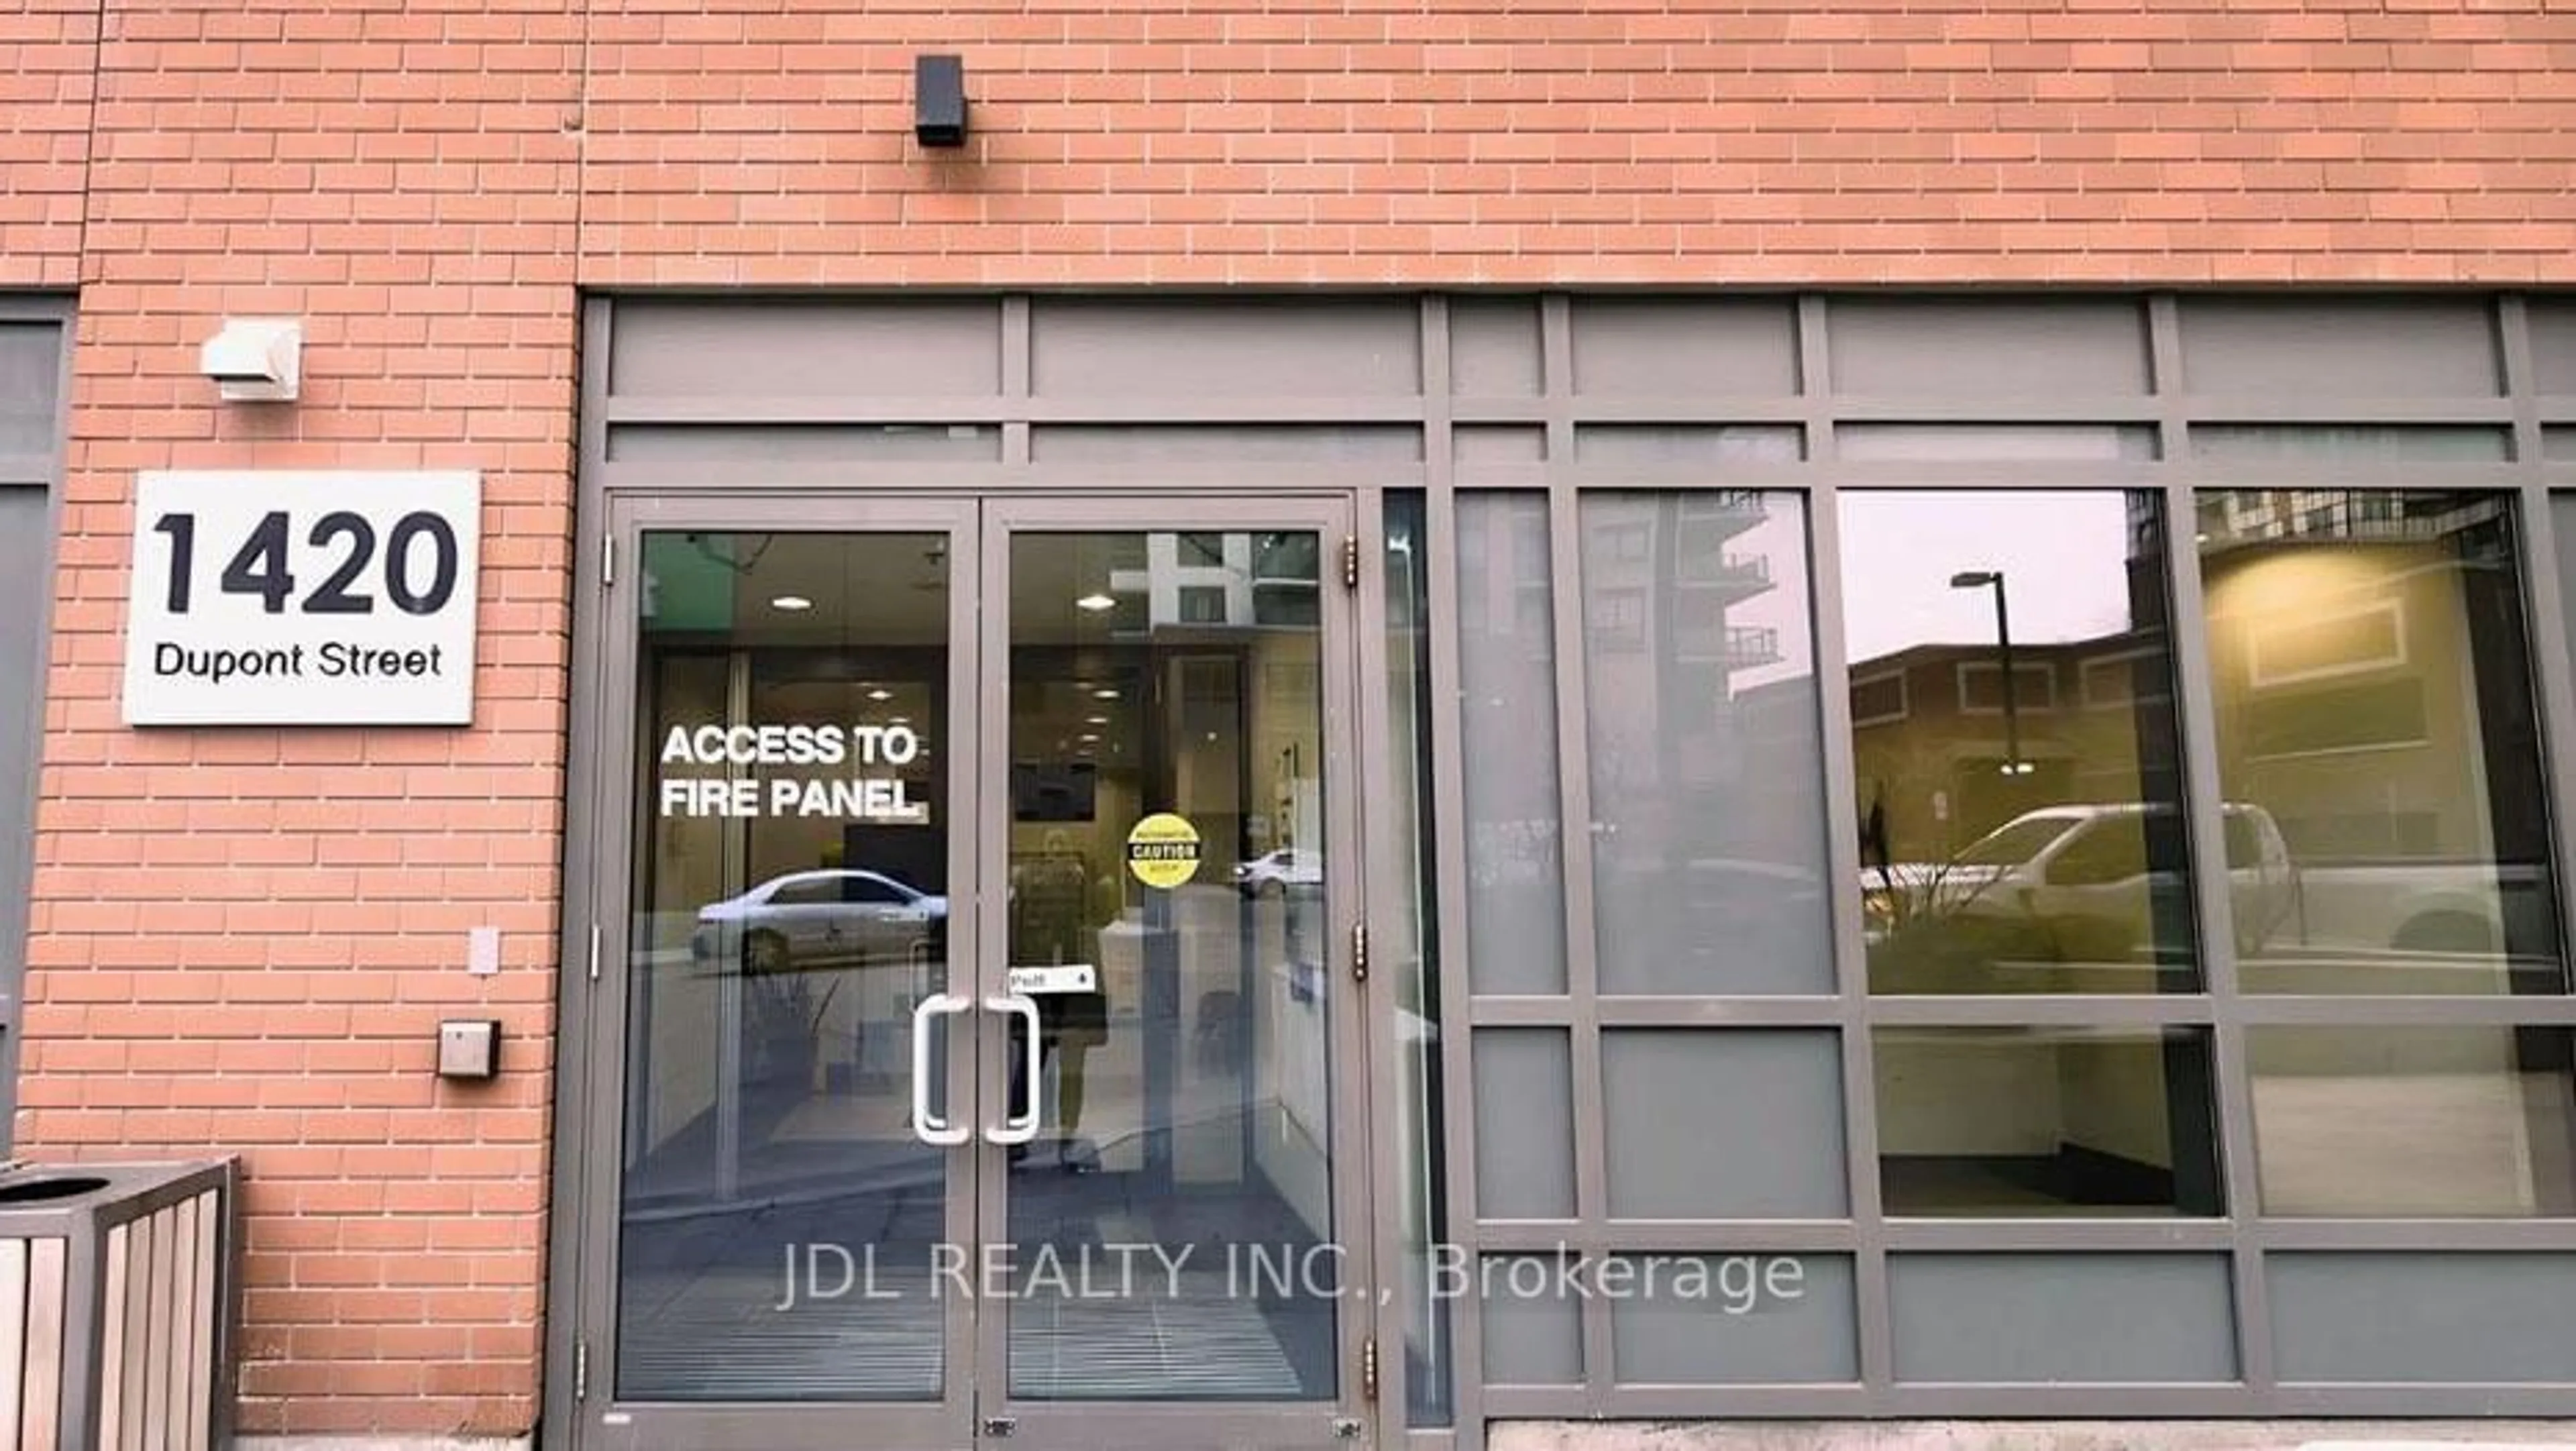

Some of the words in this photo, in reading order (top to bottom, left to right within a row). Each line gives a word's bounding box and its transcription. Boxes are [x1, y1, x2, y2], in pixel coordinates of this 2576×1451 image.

[152, 511, 458, 615] 1420
[155, 642, 303, 684] Dupont
[319, 642, 441, 677] Street
[661, 724, 845, 764] ACCESS
[854, 724, 918, 764] TO
[661, 779, 759, 817] FIRE
[771, 779, 921, 817] PANEL
[1132, 844, 1195, 859] CAUTION
